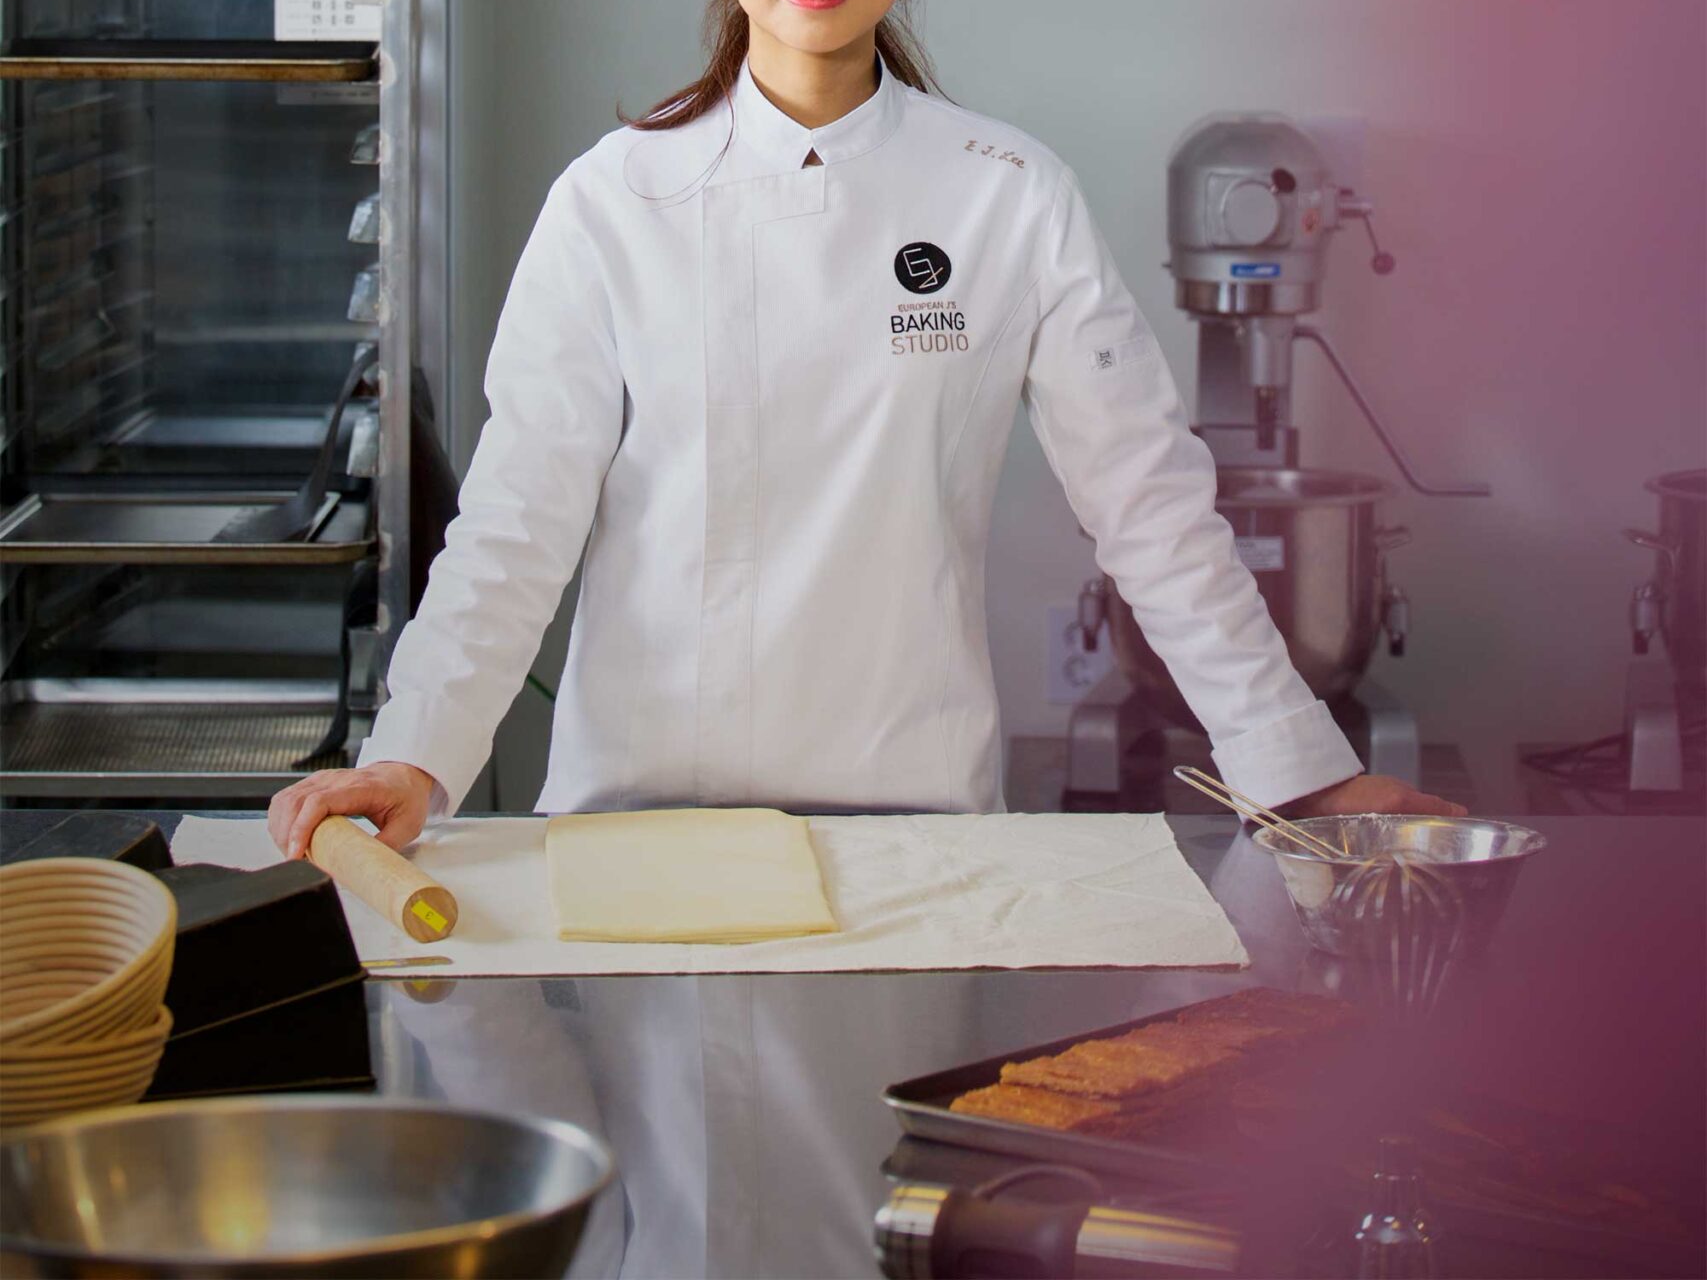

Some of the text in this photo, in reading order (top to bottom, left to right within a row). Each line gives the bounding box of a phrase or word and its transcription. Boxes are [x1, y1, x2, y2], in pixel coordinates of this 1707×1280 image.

[898, 302, 943, 312] EUROPEAN
[891, 312, 965, 333] BAKING
[891, 333, 969, 355] STUDIO
